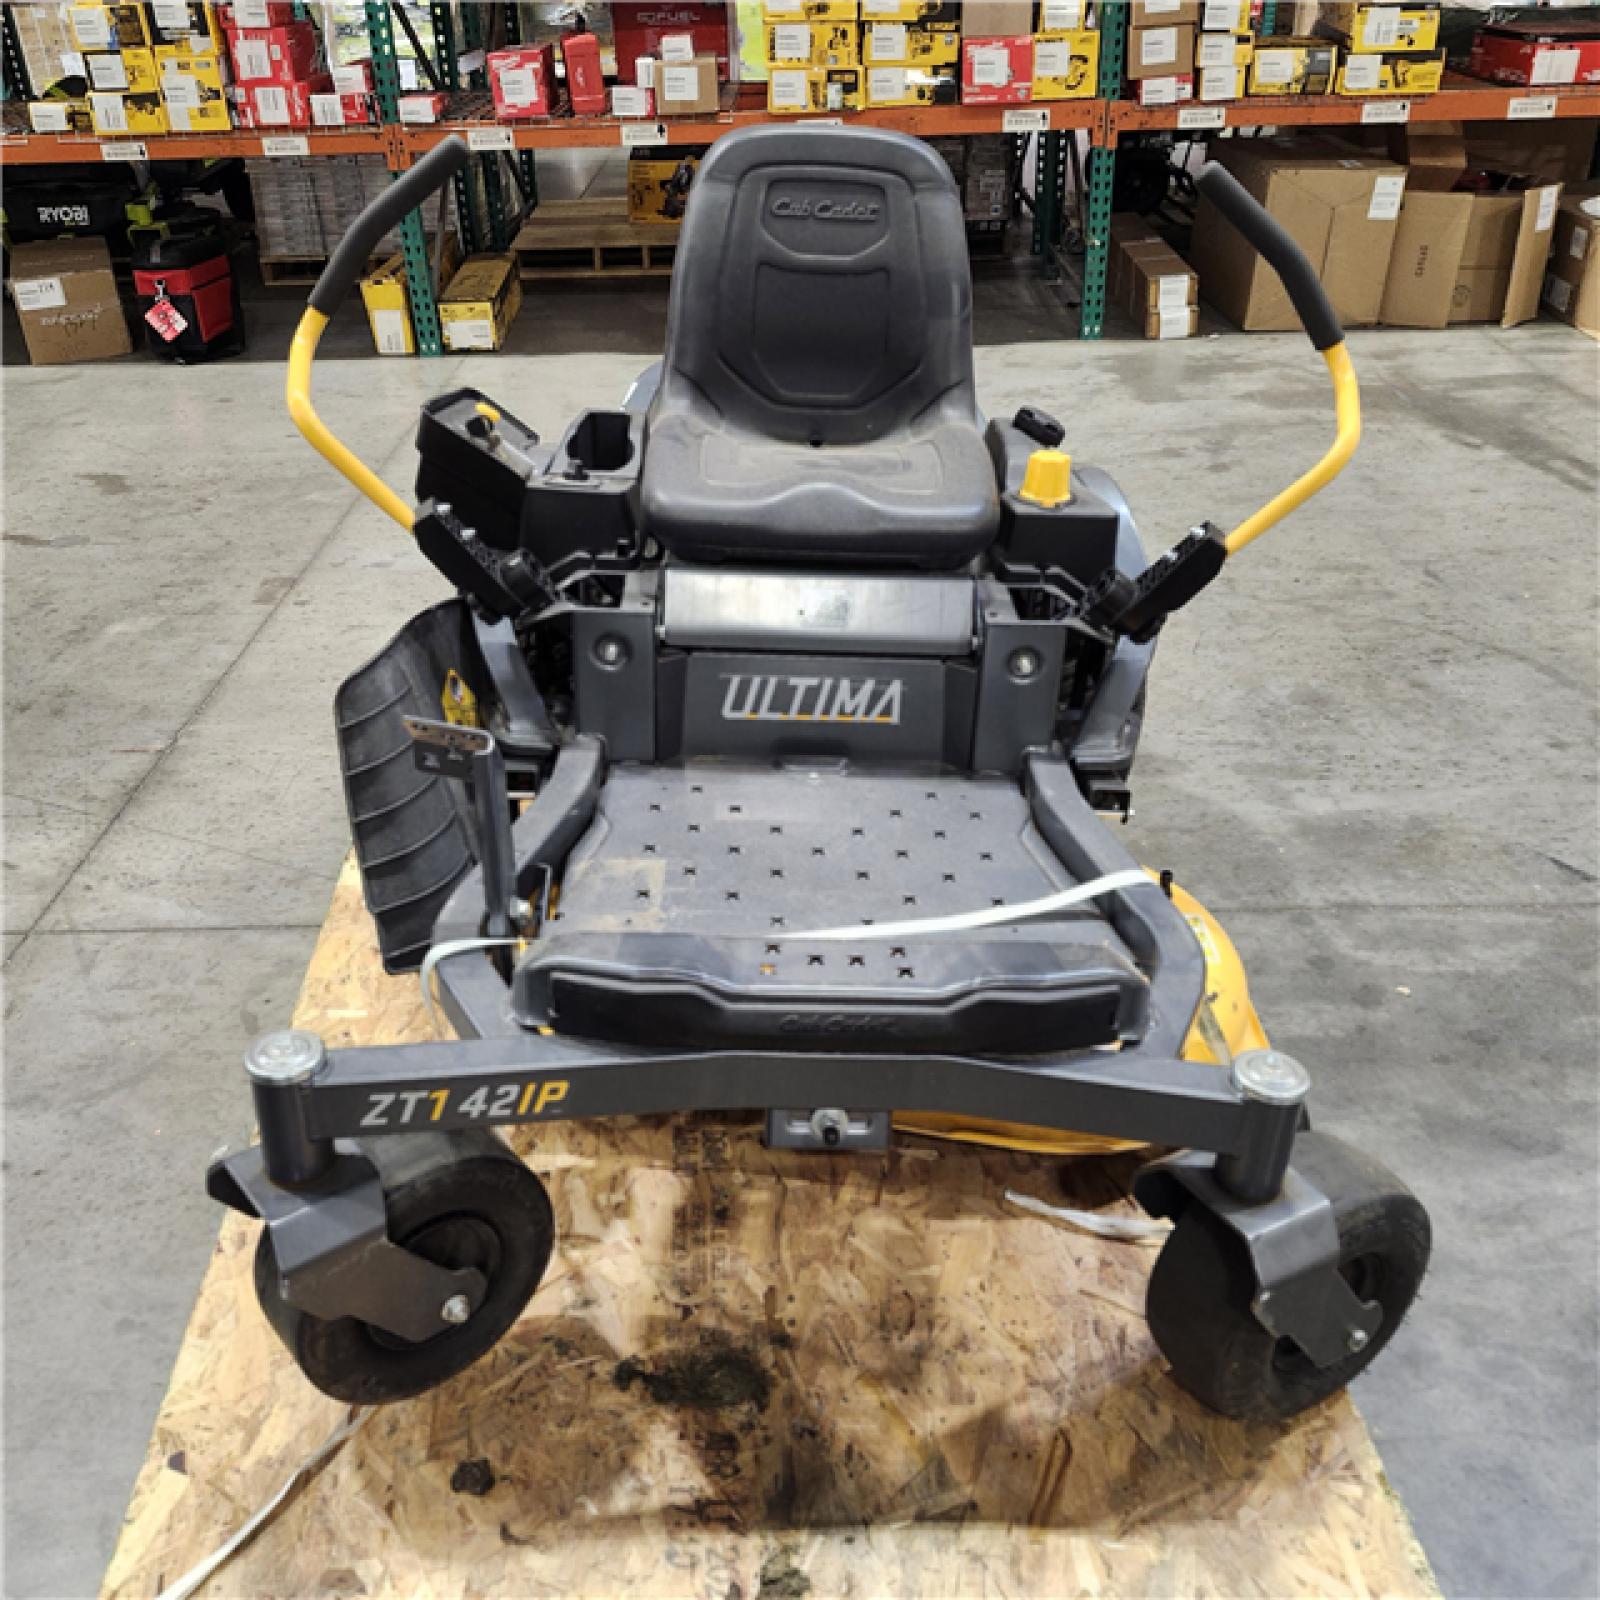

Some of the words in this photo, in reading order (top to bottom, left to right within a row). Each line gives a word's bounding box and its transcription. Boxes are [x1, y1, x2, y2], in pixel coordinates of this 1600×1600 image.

[37, 205, 90, 225] RYOBI
[721, 673, 903, 725] ULTIMA
[359, 1088, 450, 1128] ZT1
[457, 1079, 570, 1120] 42IP
